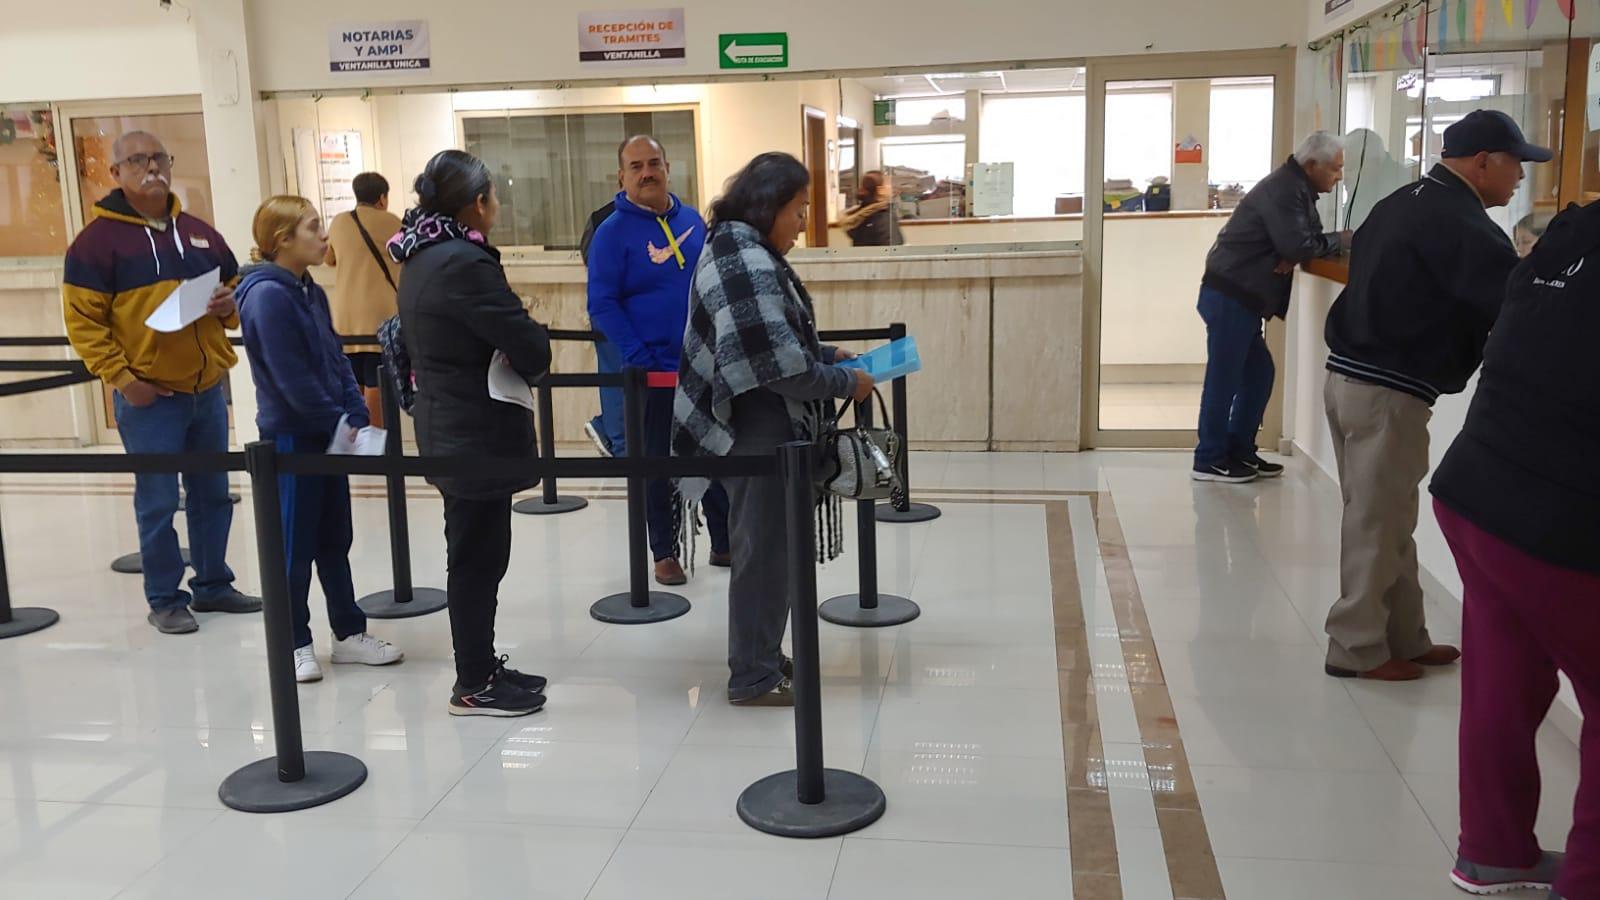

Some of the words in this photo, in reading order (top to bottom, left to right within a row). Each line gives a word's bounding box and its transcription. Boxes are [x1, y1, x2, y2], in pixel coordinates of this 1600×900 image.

[658, 21, 674, 31] DE
[342, 29, 414, 42] NOTARIAS
[602, 33, 661, 44] TRAMITES
[354, 46, 364, 57] Y
[367, 44, 403, 56] AMPI
[603, 50, 661, 60] VENTANILLA
[339, 61, 393, 71] VENTANILLA
